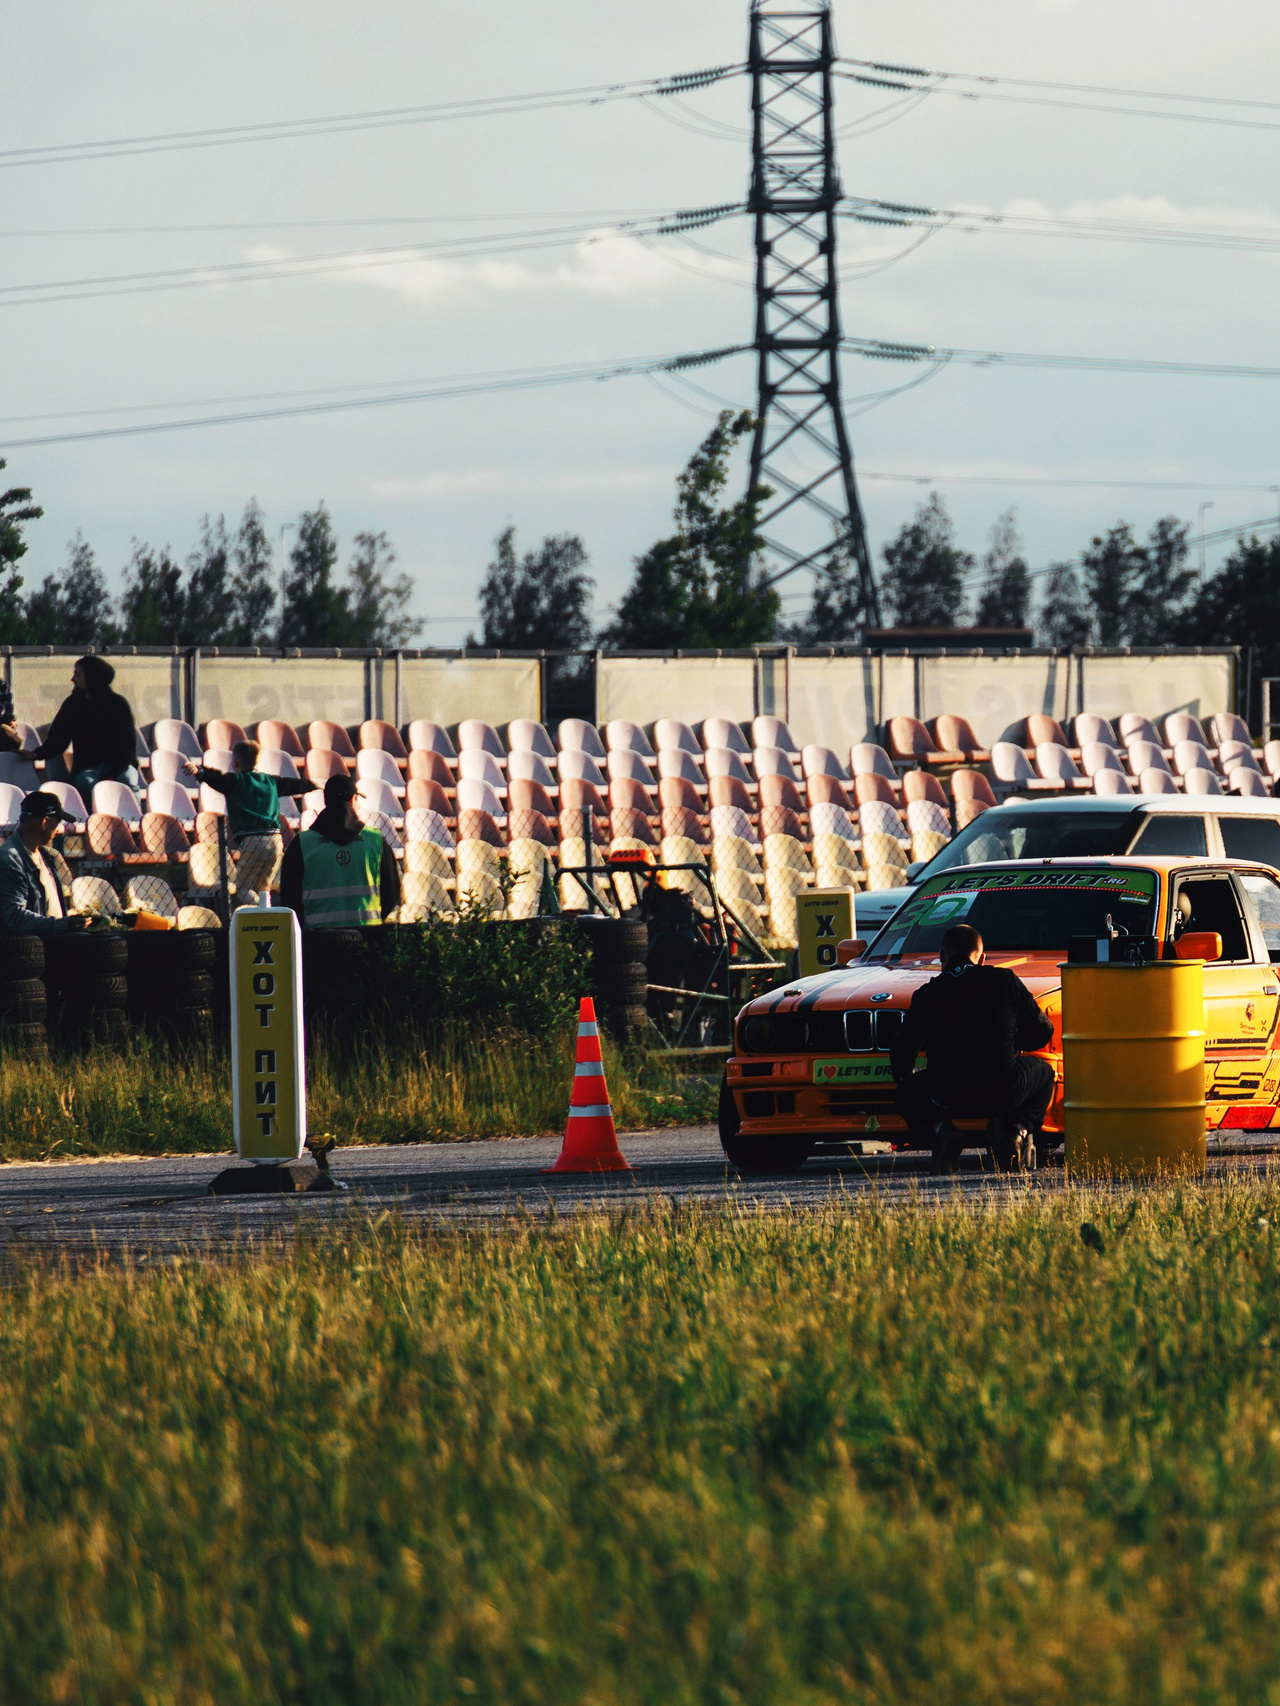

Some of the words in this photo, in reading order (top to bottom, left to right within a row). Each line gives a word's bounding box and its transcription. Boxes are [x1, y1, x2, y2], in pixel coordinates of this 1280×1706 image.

[942, 874, 1020, 892] LET'S
[888, 897, 968, 931] 30
[252, 941, 276, 1028] ХОТ
[837, 1065, 872, 1077] LET'S
[254, 1050, 279, 1137] ПИТ
